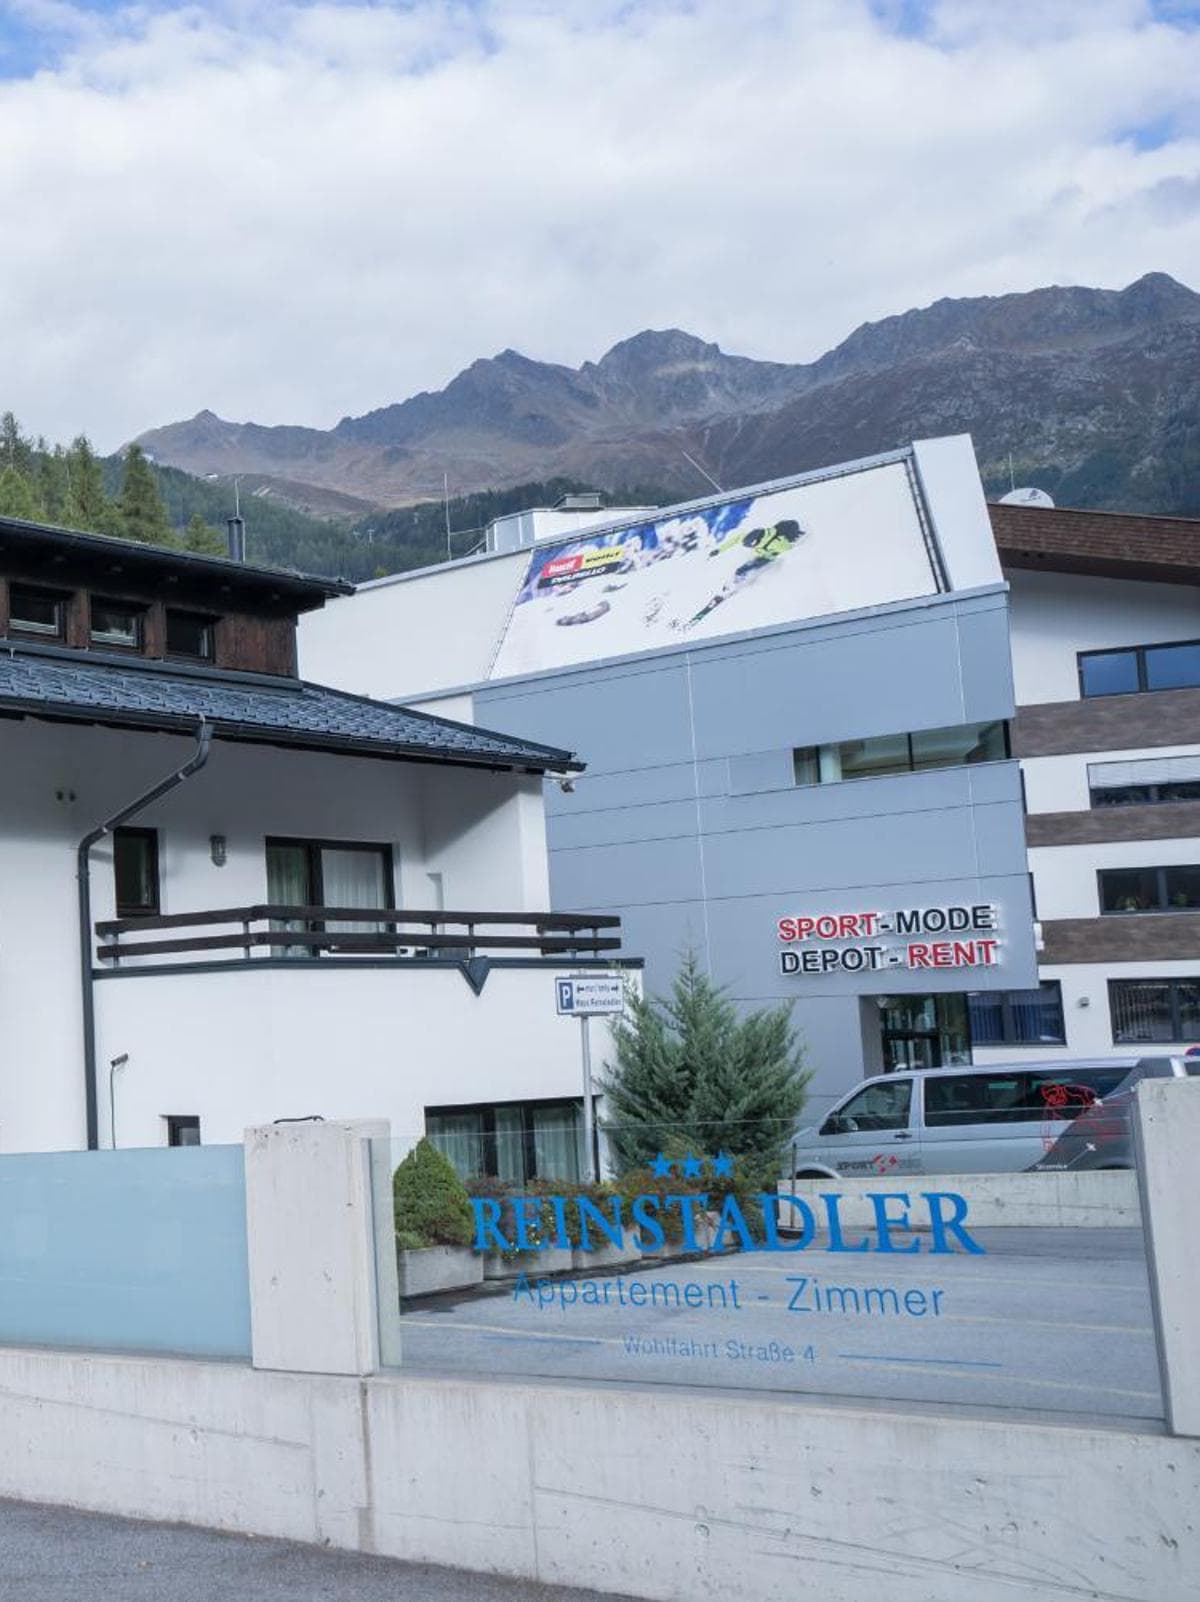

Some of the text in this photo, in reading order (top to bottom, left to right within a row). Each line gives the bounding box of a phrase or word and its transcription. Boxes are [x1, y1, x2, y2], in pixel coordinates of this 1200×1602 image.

[470, 1192, 987, 1255] REINSTADLER
[513, 1270, 741, 1311] Appartement
[785, 1277, 945, 1316] Zimmer
[623, 1336, 815, 1363] Wohlfahrt Straße 4
